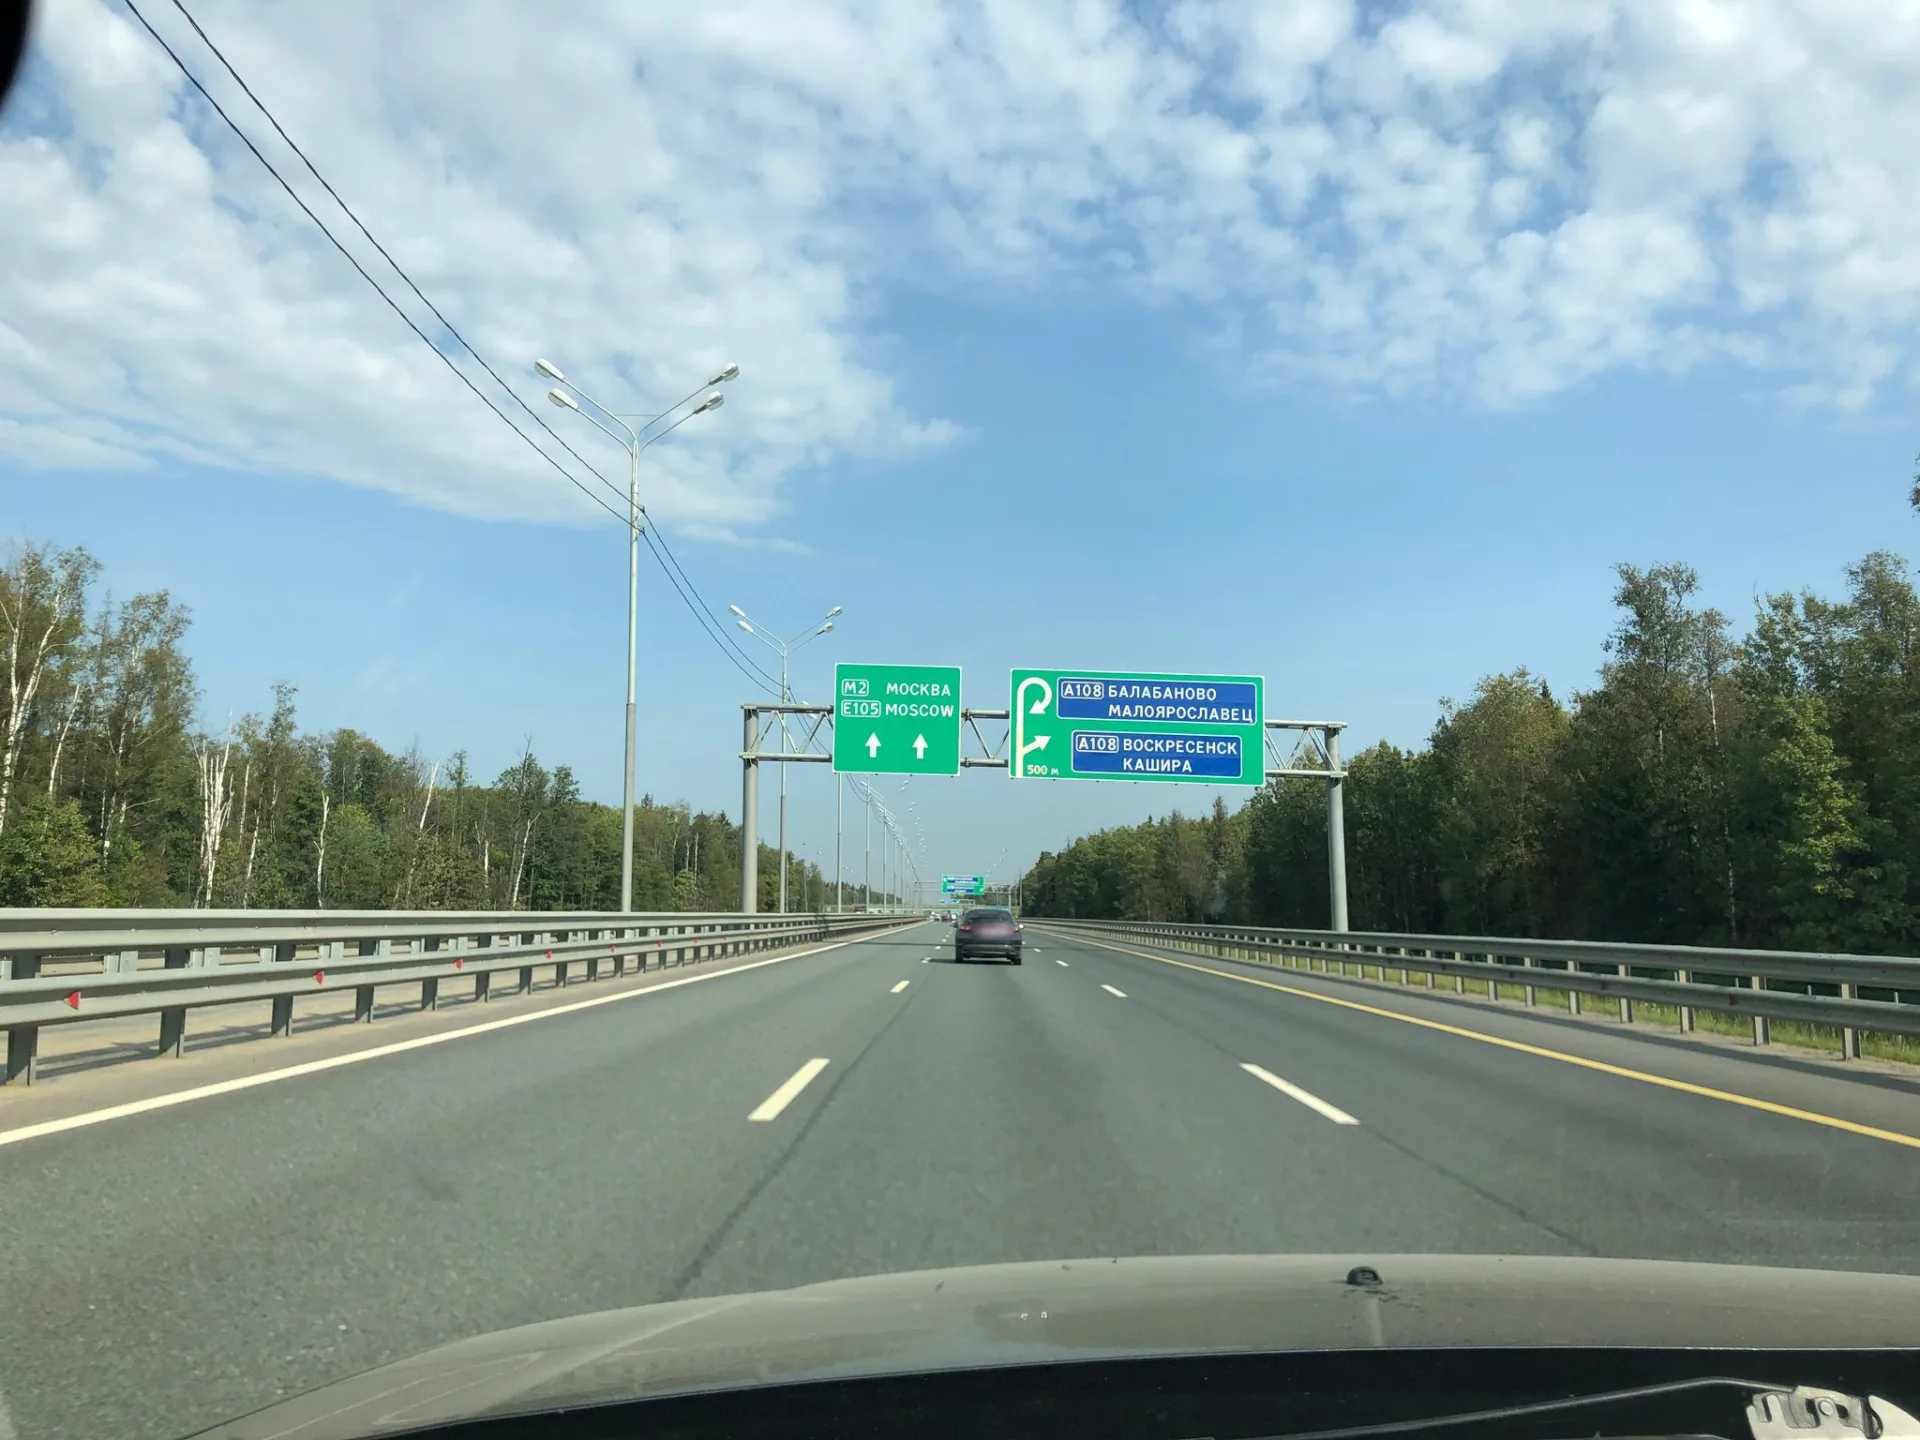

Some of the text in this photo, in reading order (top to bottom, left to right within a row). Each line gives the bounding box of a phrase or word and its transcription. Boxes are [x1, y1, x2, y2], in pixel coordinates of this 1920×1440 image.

[844, 681, 951, 696] М2 МОСКВА
[1063, 684, 1217, 701] А108 БАЛАБАНОВО
[843, 702, 954, 717] E105 MOSCOW
[1108, 704, 1253, 723] МАЛОЯРОСЛАВЕЦ
[1078, 737, 1237, 755] А108 ВОСКРЕСЕНСК
[1027, 765, 1048, 775] 500
[1123, 758, 1192, 772] КАШИРА
